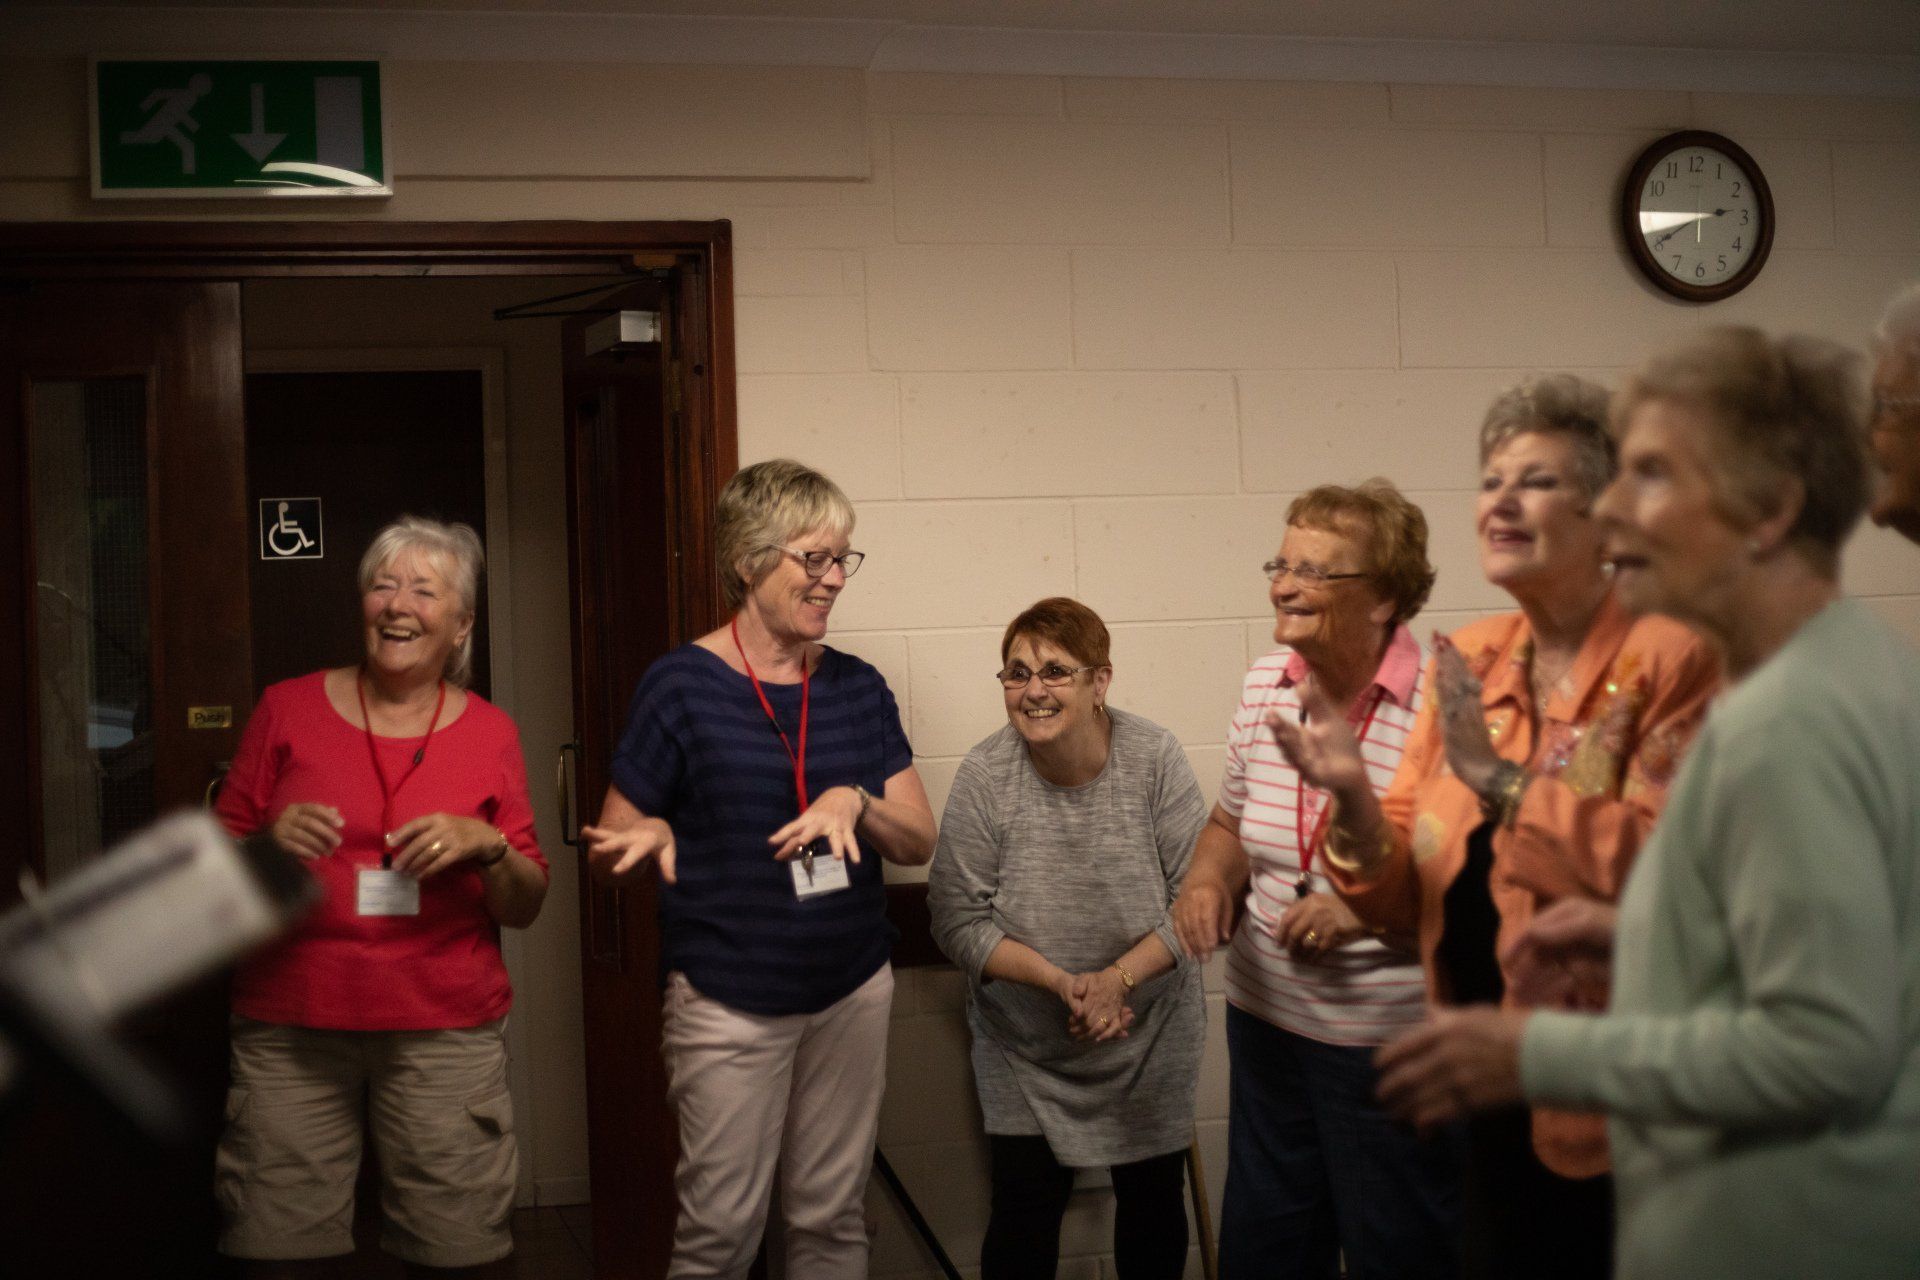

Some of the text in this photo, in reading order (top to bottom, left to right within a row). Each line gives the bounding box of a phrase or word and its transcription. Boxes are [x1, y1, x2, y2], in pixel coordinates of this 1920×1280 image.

[1667, 162, 1678, 178] 11
[1688, 155, 1704, 172] 12
[1716, 162, 1722, 180] 1
[1649, 180, 1665, 197] 10
[1731, 181, 1742, 198] 2
[1739, 209, 1749, 226] 3
[1731, 236, 1742, 253] 4
[1672, 255, 1682, 271] 7
[1695, 262, 1705, 278] 6
[1716, 255, 1727, 272] 5
